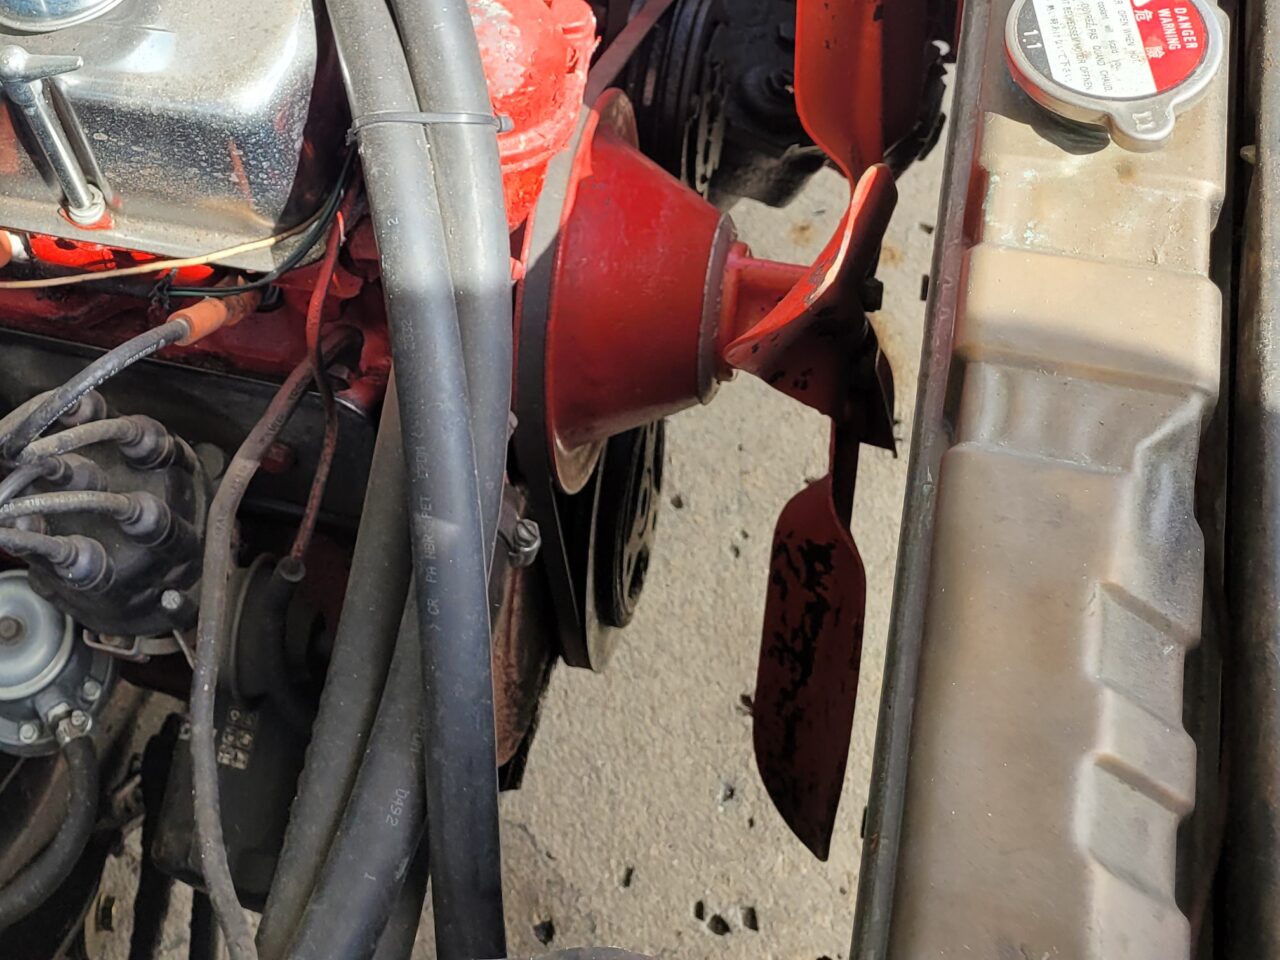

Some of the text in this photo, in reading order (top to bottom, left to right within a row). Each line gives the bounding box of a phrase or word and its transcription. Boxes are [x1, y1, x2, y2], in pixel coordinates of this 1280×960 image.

[1117, 9, 1130, 28] OPEN
[1173, 7, 1199, 50] DANGER
[1022, 29, 1042, 50] 1.1
[1123, 28, 1136, 47] WHEN
[1157, 8, 1182, 51] WARNING
